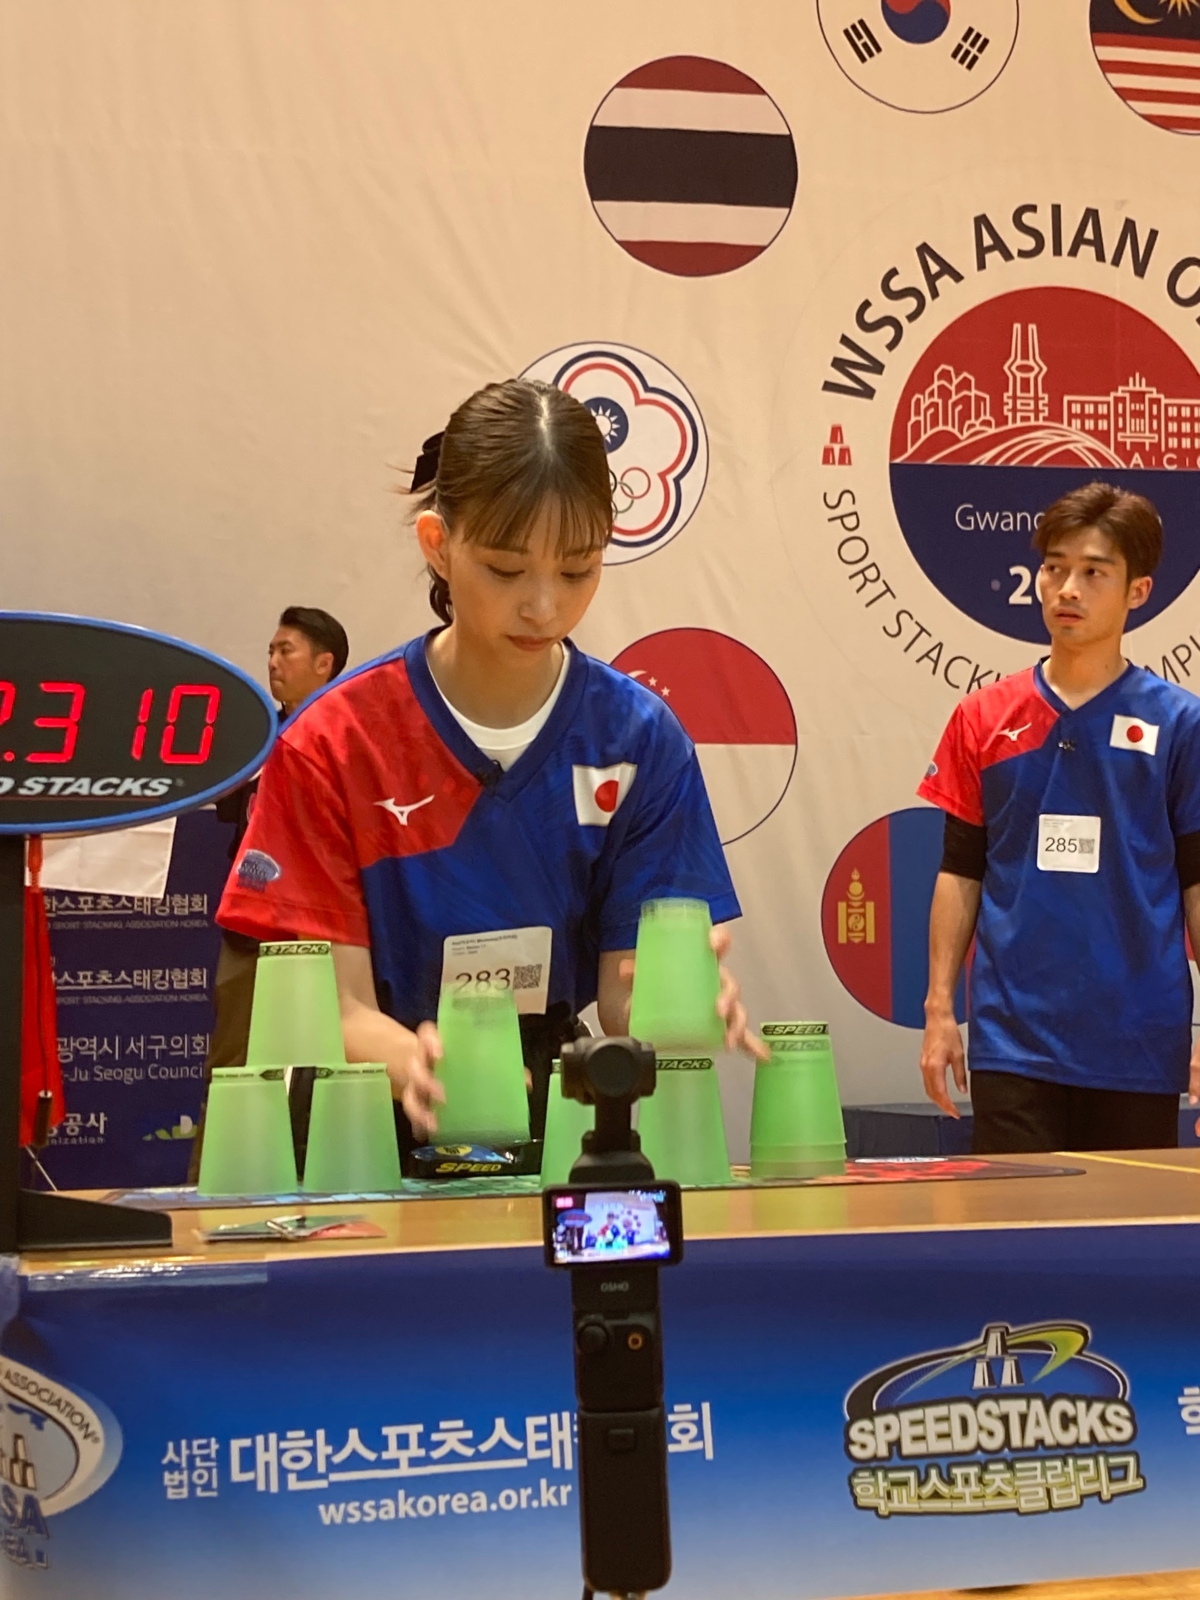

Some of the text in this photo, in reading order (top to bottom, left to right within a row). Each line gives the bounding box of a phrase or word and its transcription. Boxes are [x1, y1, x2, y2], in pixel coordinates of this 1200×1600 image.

[821, 241, 965, 400] WSSA
[973, 203, 1159, 278] ASIAN
[823, 489, 897, 609] SPORT
[18, 776, 173, 796] STACKS
[1045, 837, 1078, 853] 285
[267, 944, 329, 955] STACKS
[52, 967, 208, 991] 스포츠스태킹협회
[453, 968, 511, 996] 283
[773, 1025, 824, 1035] SPEED
[125, 1033, 209, 1059] 서구의회
[94, 1065, 142, 1085] Seogu
[436, 1162, 502, 1173] SPEED
[4, 1368, 97, 1440] ASSOCIATION
[849, 1398, 1135, 1460] SPEEDSTACKS
[161, 1437, 219, 1468] 사단
[230, 1402, 713, 1493] 대한스포츠스태회
[163, 1468, 219, 1500] 법인
[853, 1453, 1144, 1516] 학교스포츠클럽리그
[319, 1478, 572, 1526] wssakorea.or.kr
